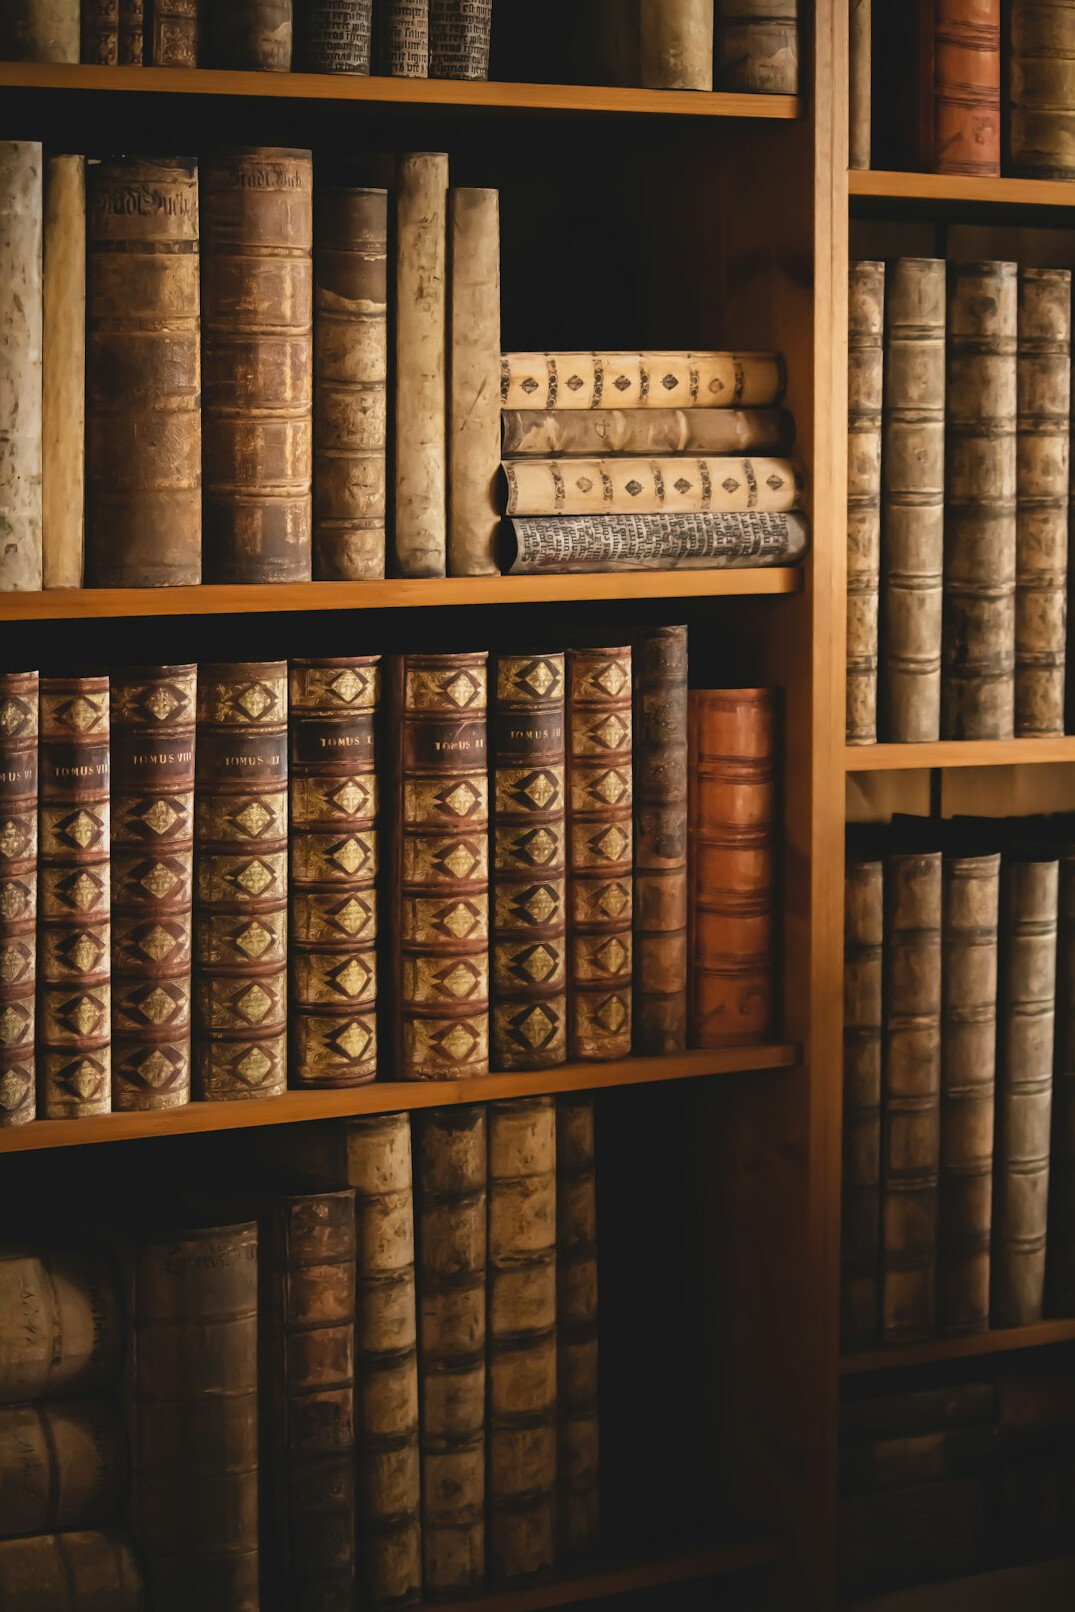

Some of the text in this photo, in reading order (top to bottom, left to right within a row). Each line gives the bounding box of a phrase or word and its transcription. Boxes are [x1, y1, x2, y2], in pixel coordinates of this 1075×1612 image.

[509, 729, 549, 739] TOMUS
[320, 735, 360, 747] TOMUS
[434, 740, 471, 750] TOMUS
[132, 753, 175, 765] TOMUS
[224, 755, 264, 766] TOMUS
[54, 765, 94, 777] TOMUS
